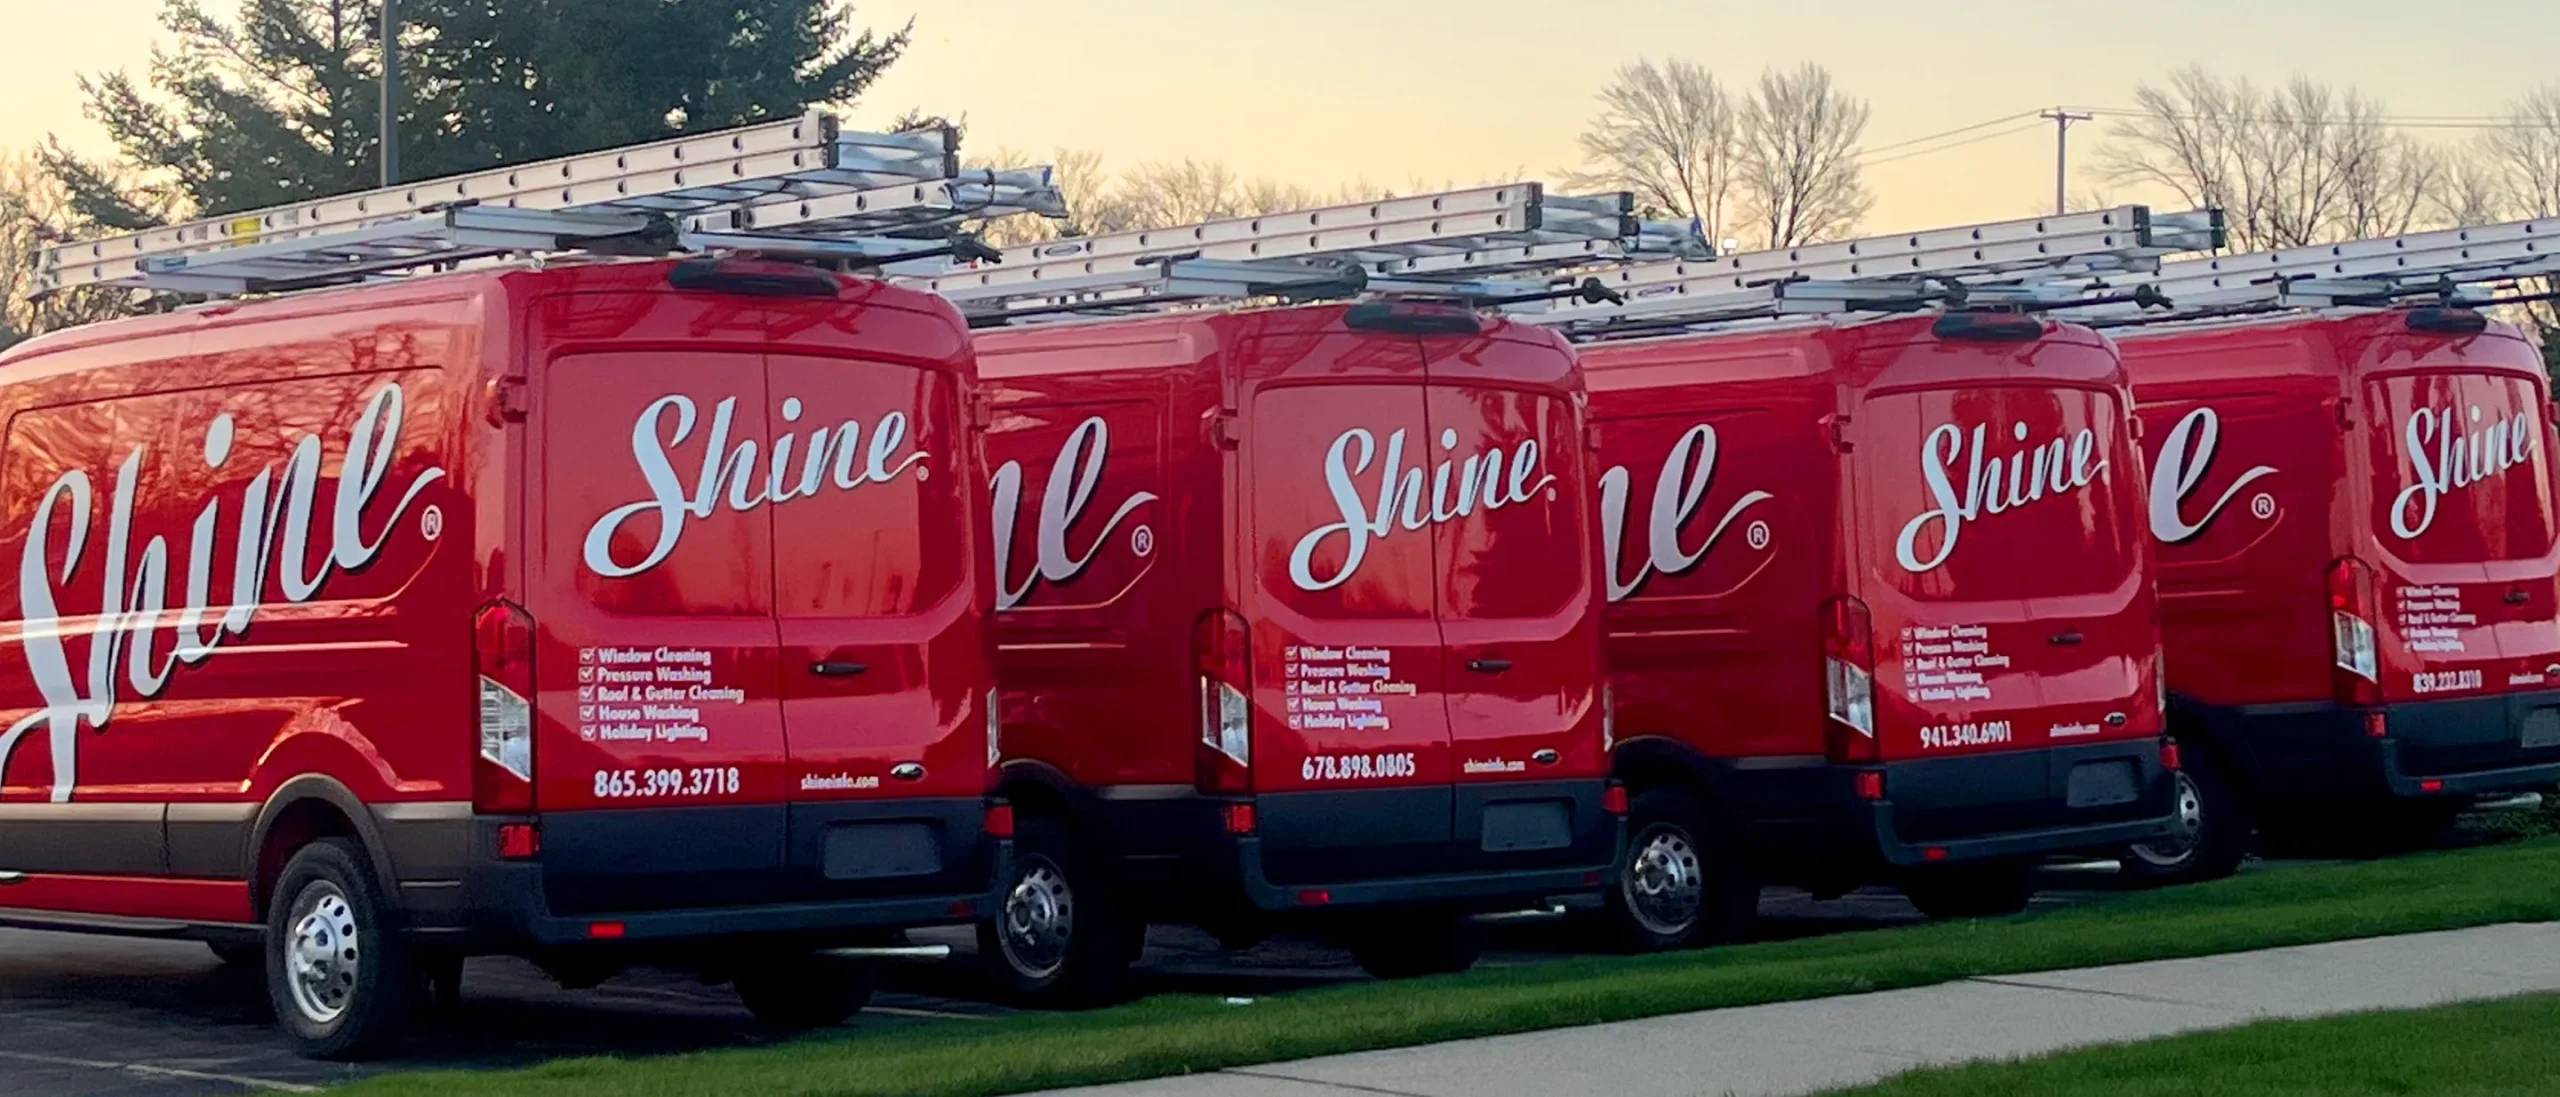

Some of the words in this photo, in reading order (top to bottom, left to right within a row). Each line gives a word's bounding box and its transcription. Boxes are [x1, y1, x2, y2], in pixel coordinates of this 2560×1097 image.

[583, 394, 931, 577] Shine
[2390, 405, 2538, 539] Shine
[1288, 427, 1556, 591] Shine
[1894, 421, 2109, 572] Shine
[0, 382, 446, 803] Shine
[598, 648, 653, 664] Window
[655, 646, 711, 665] Cleaning
[597, 666, 653, 682] Pressure
[656, 666, 711, 684] Washing
[598, 685, 629, 701] Roof
[631, 686, 642, 701] &
[645, 685, 687, 701] Gutter
[689, 685, 745, 704] Cleaning
[598, 705, 641, 721] House
[643, 704, 699, 723] Washing
[600, 724, 653, 742] Holiday
[655, 724, 708, 742] Lighting
[1920, 720, 2012, 749] 941.340.6901
[801, 771, 879, 790] shineinfo.com
[1302, 753, 1416, 780] 678.898.0805
[594, 767, 739, 798] 865.399.3718
